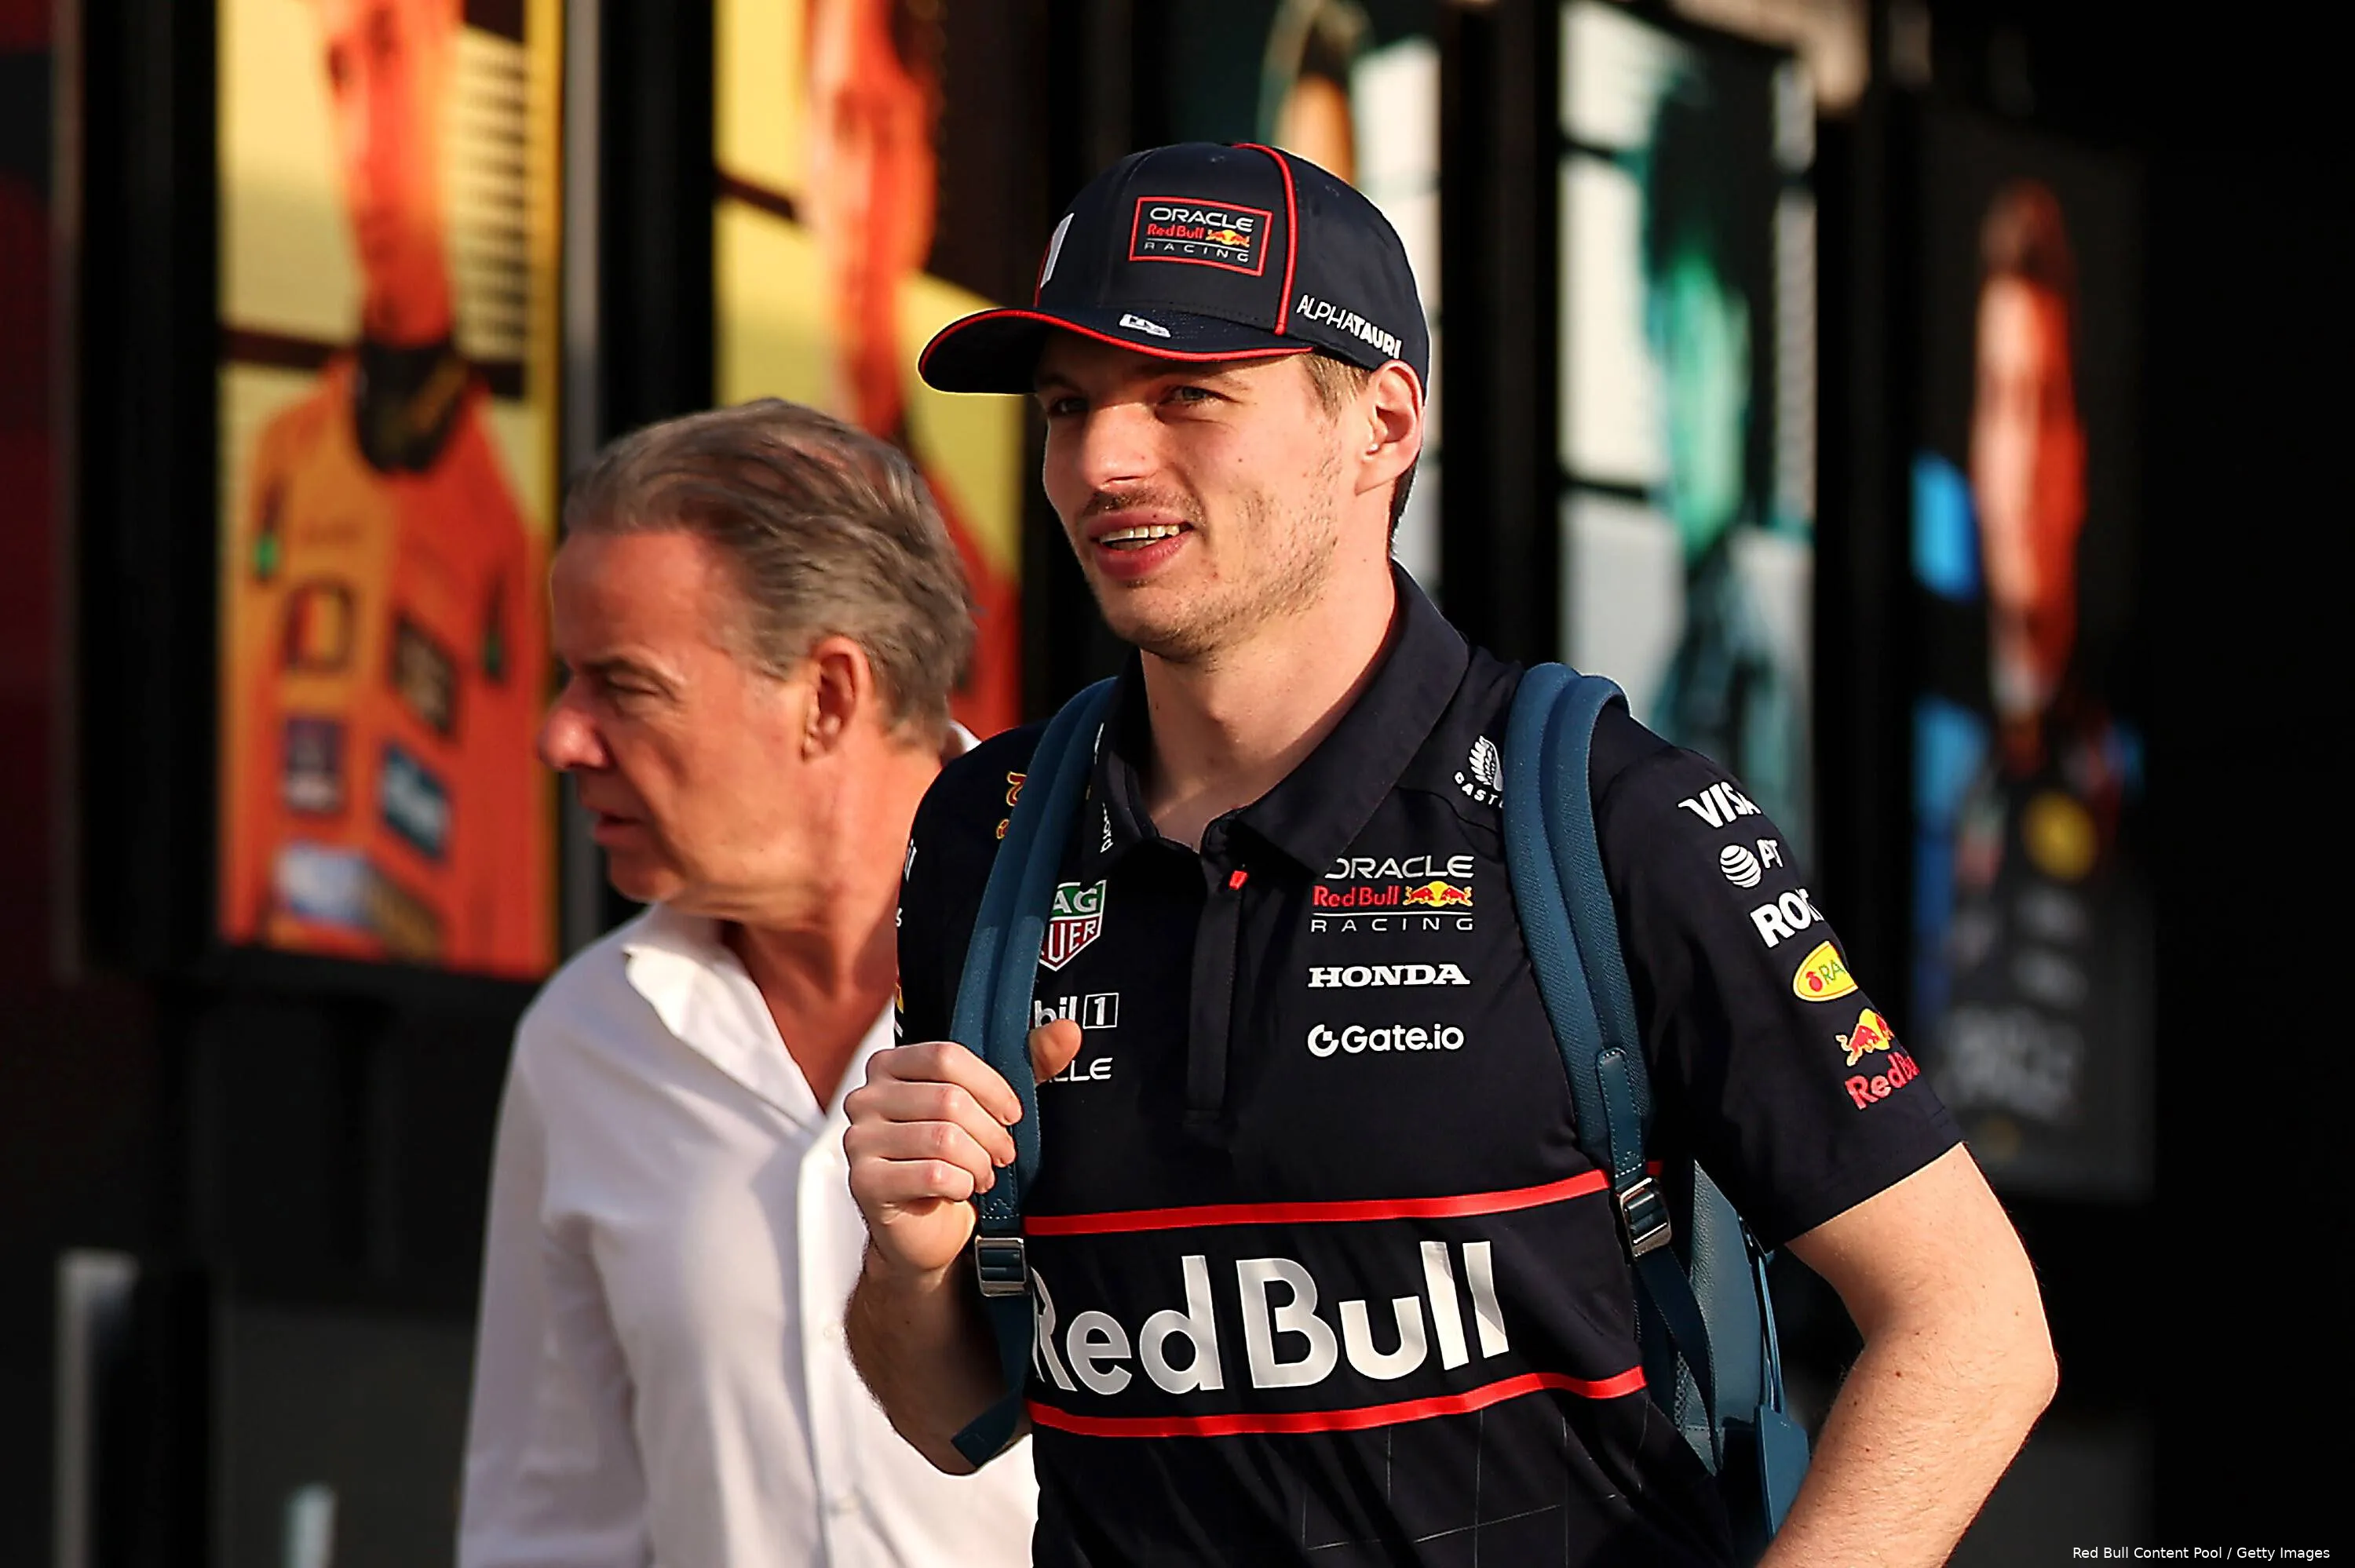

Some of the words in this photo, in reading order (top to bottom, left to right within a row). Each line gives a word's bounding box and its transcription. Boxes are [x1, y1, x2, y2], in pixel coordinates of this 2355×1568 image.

[1147, 223, 1175, 237] Red
[1176, 224, 1205, 239] Bull
[1149, 206, 1254, 233] ORACLE
[1144, 242, 1250, 263] RACING
[1296, 294, 1402, 359] ALPHATAURI
[1678, 781, 1762, 828] VISA
[1053, 888, 1098, 913] AG
[1312, 884, 1356, 907] Red
[1359, 884, 1400, 906] Bull
[1310, 917, 1474, 933] RACING
[1042, 920, 1097, 963] UER
[1308, 964, 1471, 988] HONDA
[1341, 1023, 1465, 1052] Gate.io
[1031, 1254, 1226, 1395] Red
[1236, 1240, 1510, 1390] Bull
